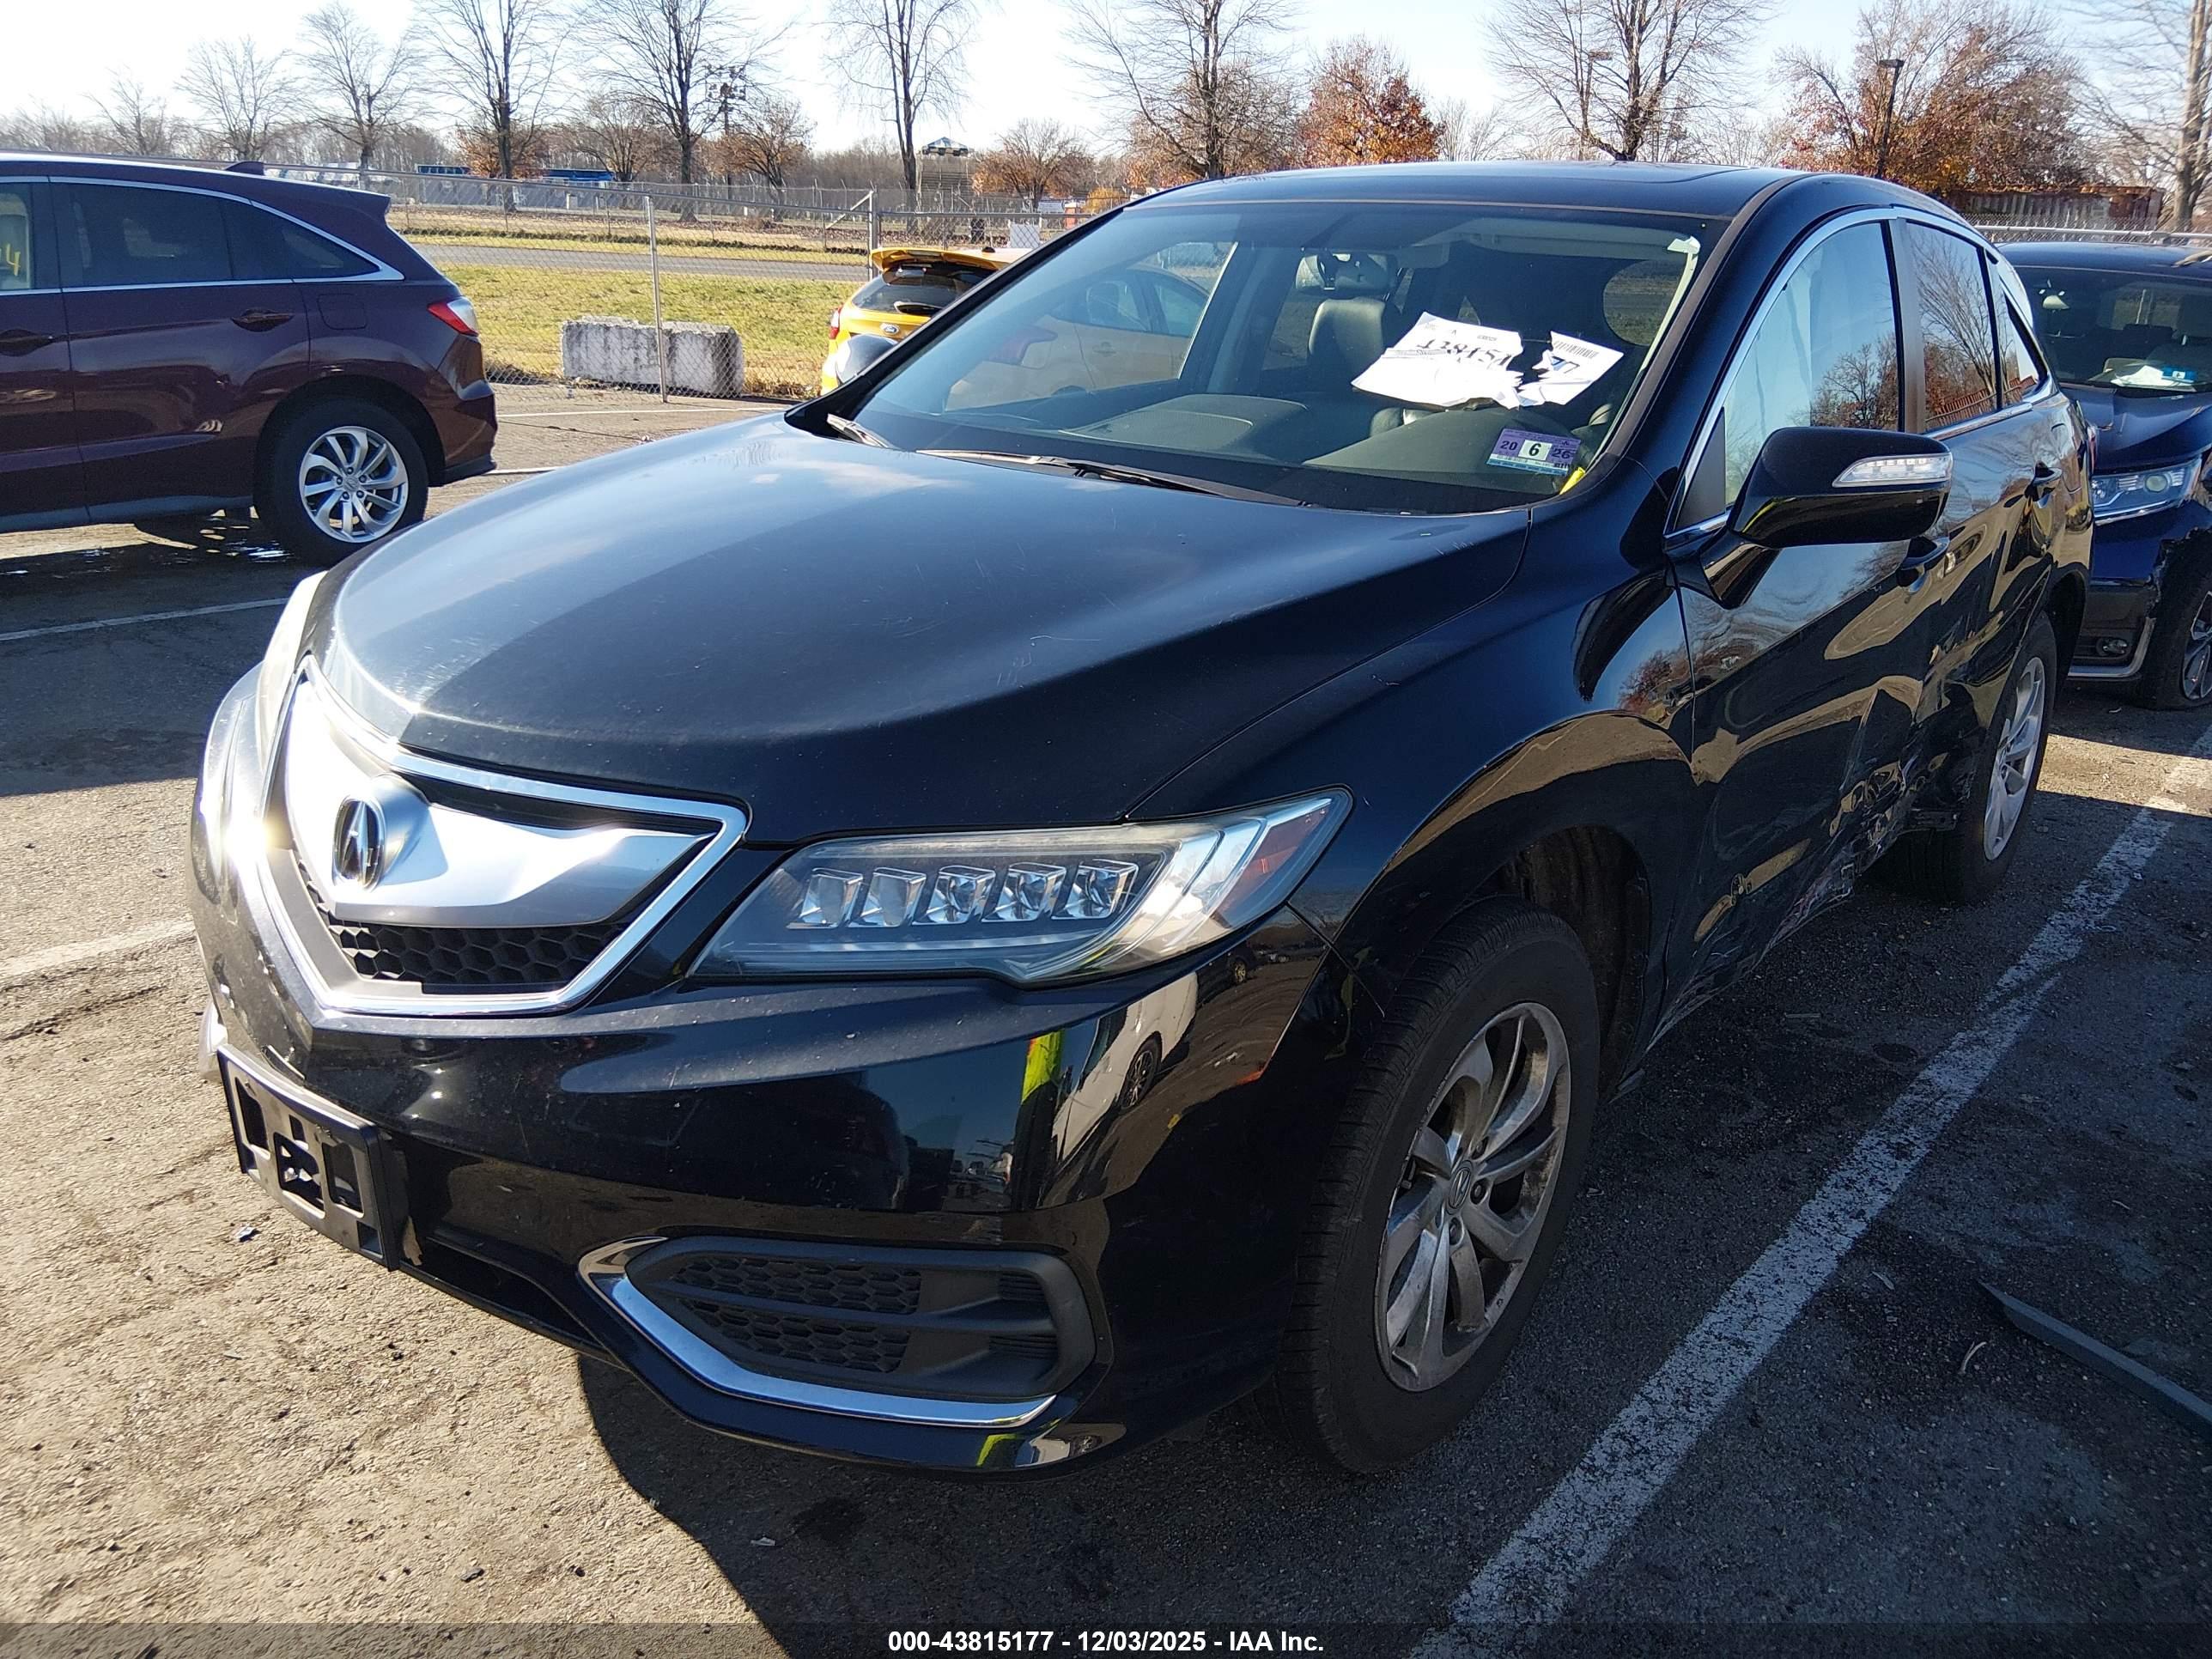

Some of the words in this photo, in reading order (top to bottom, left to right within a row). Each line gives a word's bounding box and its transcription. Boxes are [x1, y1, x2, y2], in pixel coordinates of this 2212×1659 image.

[1500, 440, 1518, 451] 20
[1528, 442, 1542, 457] 6
[1551, 448, 1571, 459] 26
